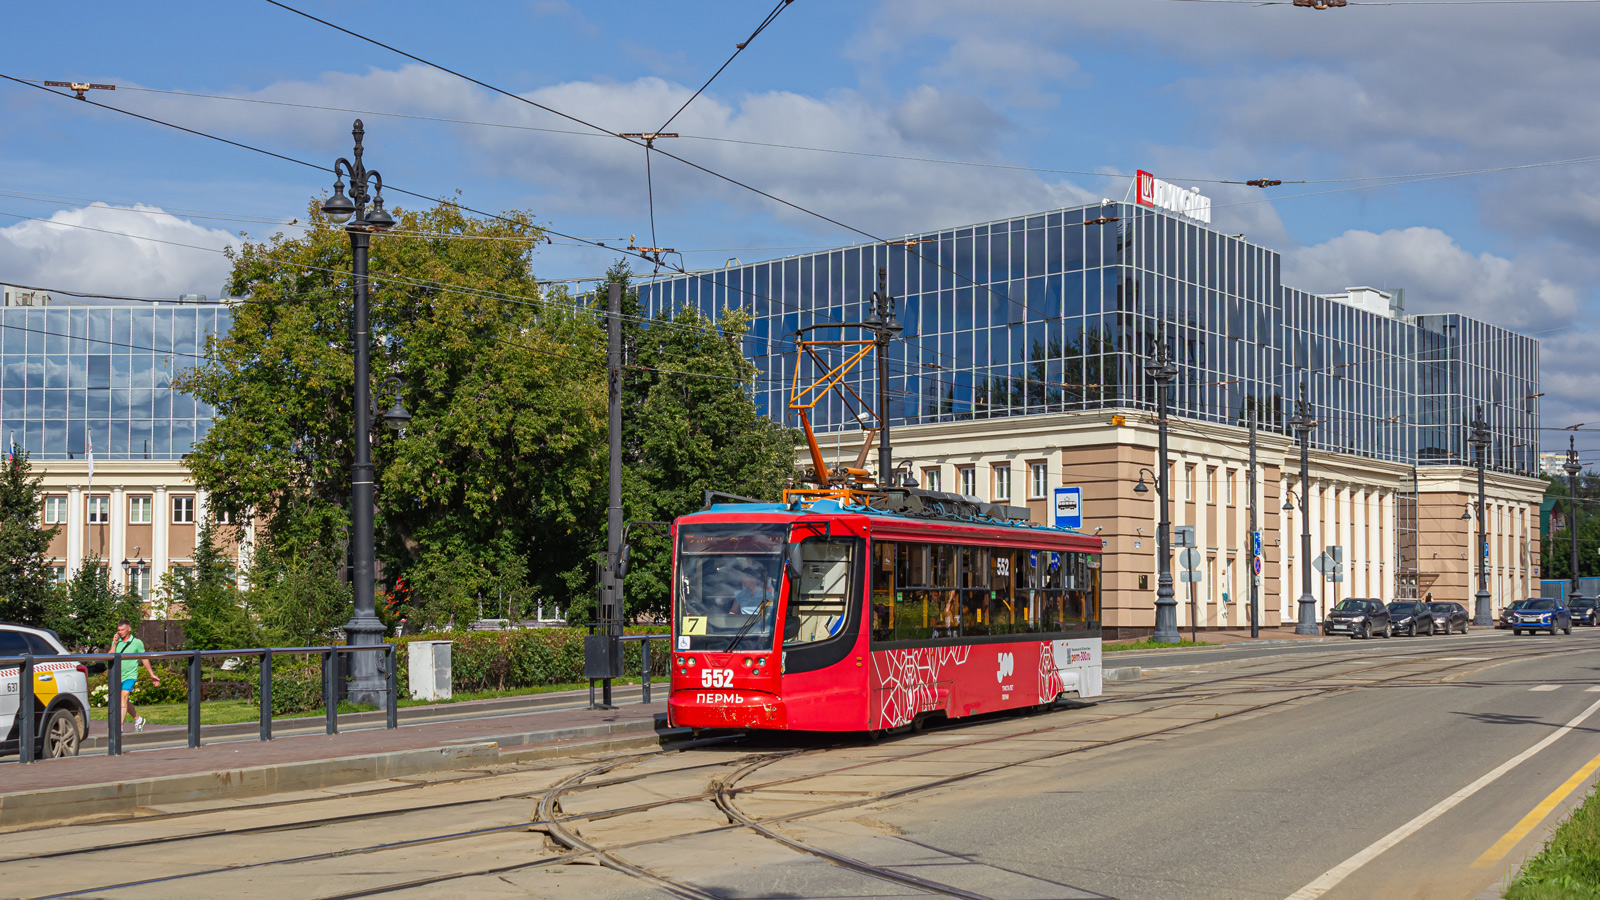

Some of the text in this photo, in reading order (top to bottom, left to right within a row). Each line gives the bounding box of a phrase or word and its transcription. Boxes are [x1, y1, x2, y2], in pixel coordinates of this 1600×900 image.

[996, 557, 1010, 577] 552
[688, 618, 699, 632] 7
[701, 669, 734, 688] 552
[696, 693, 744, 704] ПЕРМЬ
